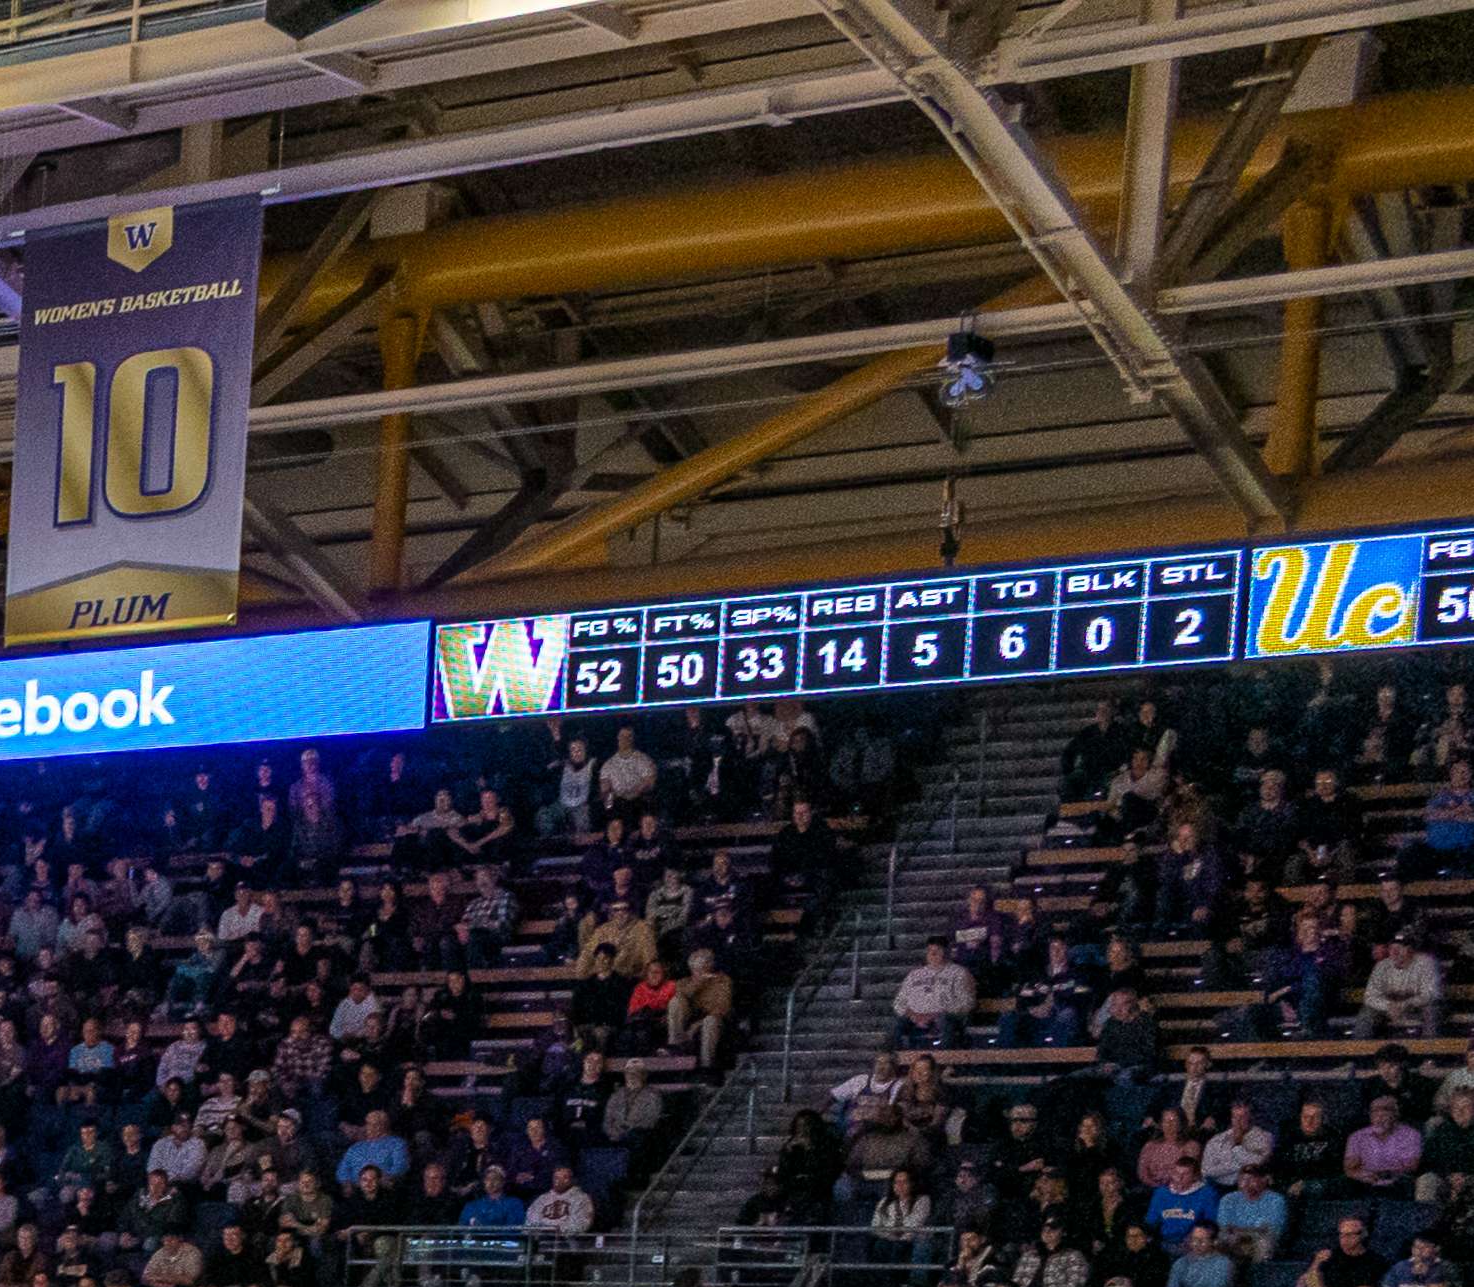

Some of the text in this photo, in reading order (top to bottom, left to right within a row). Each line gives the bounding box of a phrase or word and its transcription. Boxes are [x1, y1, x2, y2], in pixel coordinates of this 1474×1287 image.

[124, 222, 157, 250] W
[34, 279, 242, 326] WOMEN'S BASKETBALL
[54, 346, 213, 526] 10
[69, 592, 171, 628] PLUM
[813, 595, 876, 616] REB
[895, 585, 955, 608] AST
[992, 580, 1036, 599] TO
[1067, 570, 1139, 592] BLK
[1161, 565, 1228, 585] STL
[576, 609, 1202, 694] 52 50 33 14 5 6 0 2
